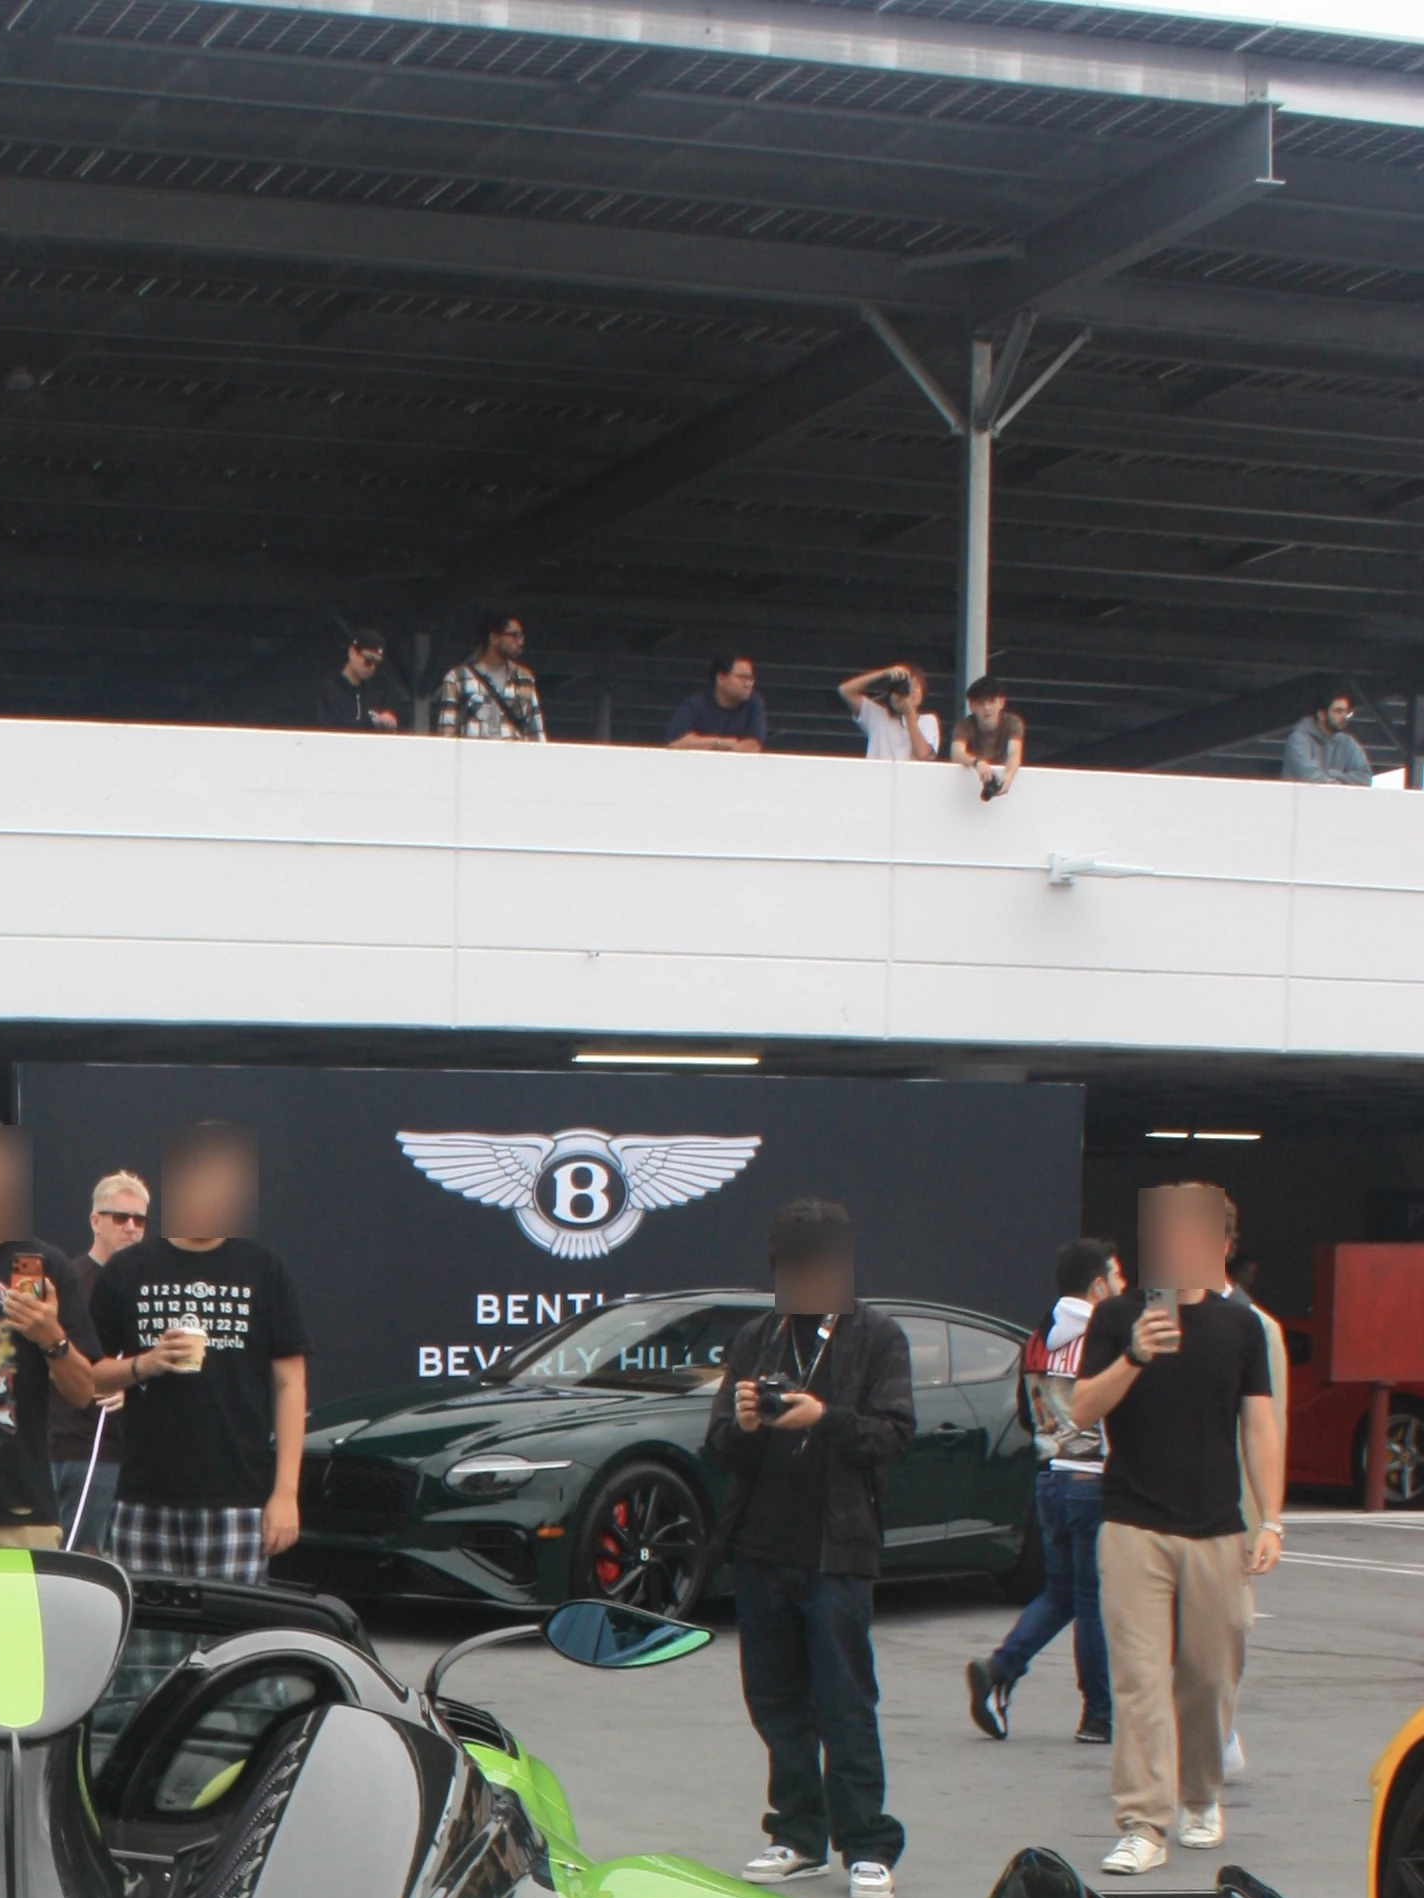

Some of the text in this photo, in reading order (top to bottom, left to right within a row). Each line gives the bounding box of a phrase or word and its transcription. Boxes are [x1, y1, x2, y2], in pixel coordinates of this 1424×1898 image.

[553, 1161, 610, 1224] B
[140, 1285, 150, 1297] 0
[152, 1285, 159, 1296] 1
[161, 1284, 170, 1296] 2
[172, 1284, 181, 1296] 3
[184, 1284, 193, 1295] 4
[207, 1285, 216, 1297] 6
[219, 1286, 229, 1297] 7
[231, 1286, 240, 1298] 8
[242, 1287, 251, 1299] 9
[137, 1300, 250, 1315] 10 11 12 13 14 15 16
[477, 1293, 641, 1325] BENT
[138, 1319, 149, 1330] 17
[152, 1318, 165, 1330] 18
[168, 1318, 180, 1330] 19
[202, 1319, 214, 1330] 21
[217, 1320, 231, 1331] 22
[234, 1320, 249, 1332] 23
[205, 1334, 245, 1350] argiela
